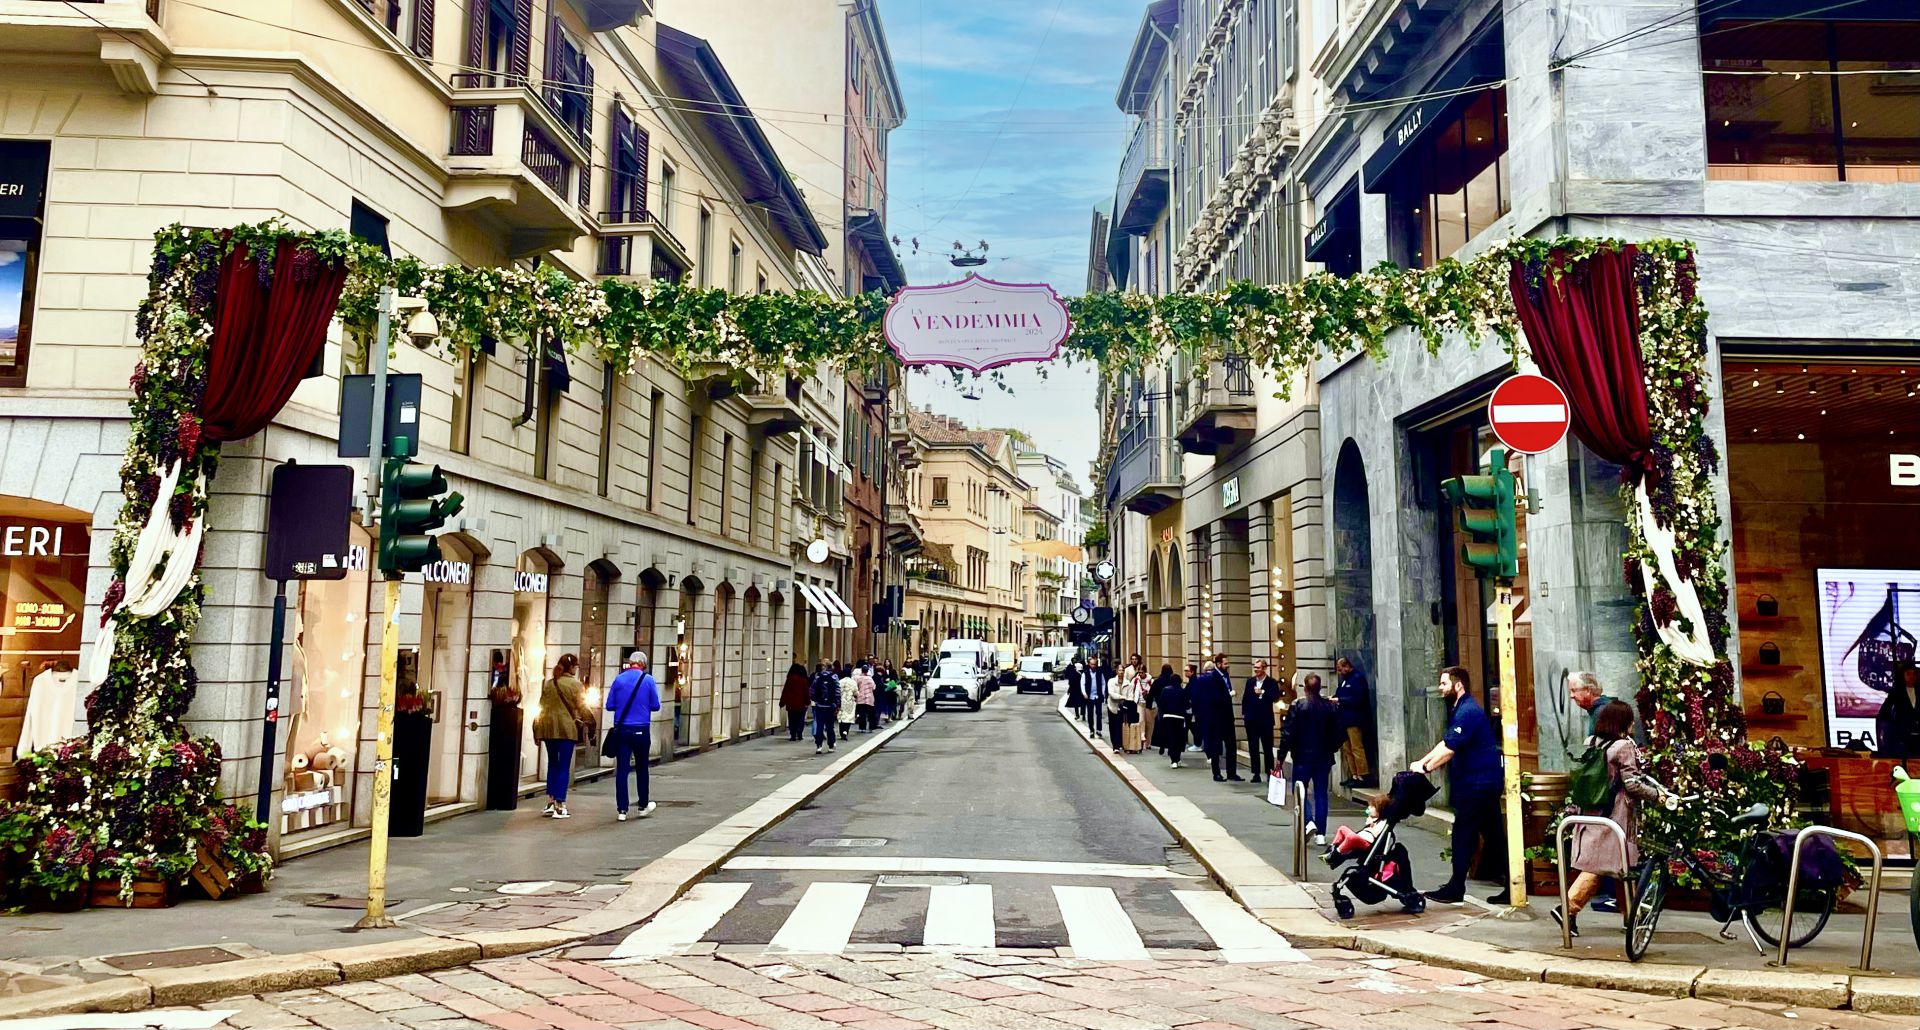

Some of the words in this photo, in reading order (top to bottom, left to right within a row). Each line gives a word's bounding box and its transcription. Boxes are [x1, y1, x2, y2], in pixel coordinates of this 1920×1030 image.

[1397, 107, 1423, 147] BALLY
[1310, 219, 1328, 246] BALLY
[912, 313, 1042, 330] VENDEMMIA
[0, 526, 63, 556] ERI
[421, 560, 470, 585] ALCONERI
